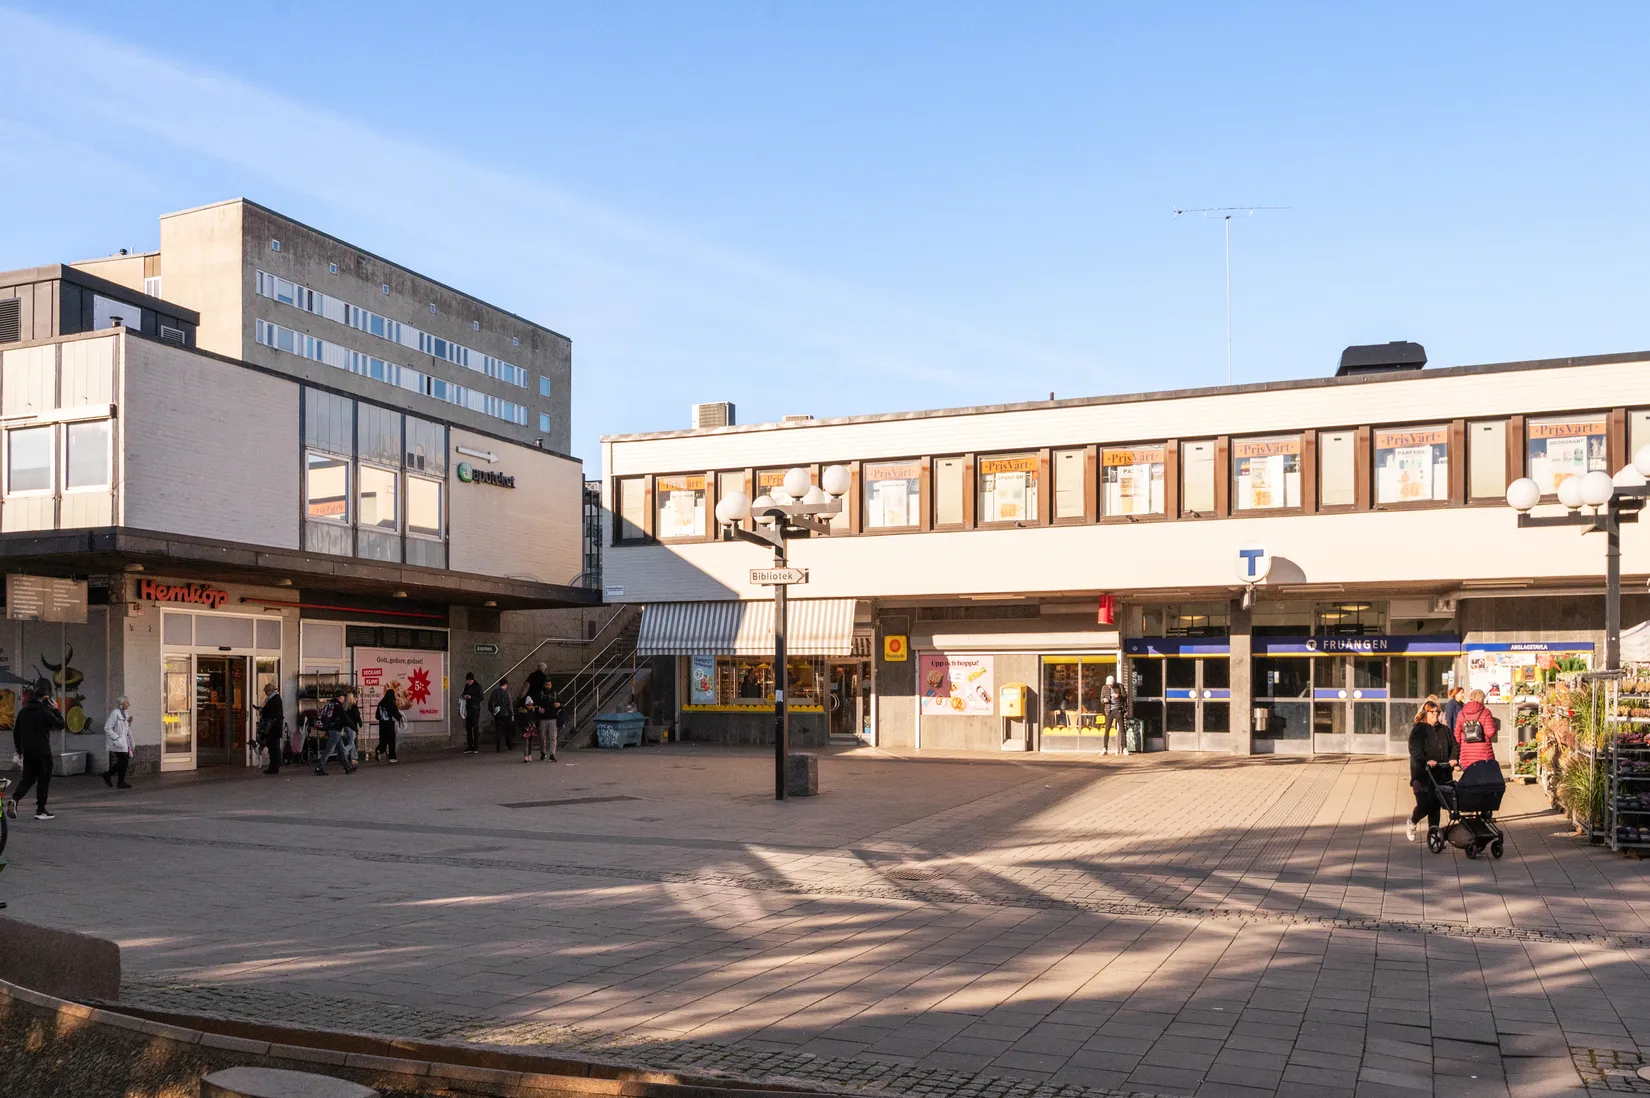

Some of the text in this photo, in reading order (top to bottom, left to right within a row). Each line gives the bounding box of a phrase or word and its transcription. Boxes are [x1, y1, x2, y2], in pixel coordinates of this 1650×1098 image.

[1540, 424, 1592, 435] PrisVärt
[1386, 432, 1434, 445] PrisVärt
[1244, 442, 1288, 454] PrisVärt
[1112, 452, 1153, 463] PrisVärt
[990, 460, 1028, 471] PrisVärt
[472, 469, 516, 488] apoteket
[874, 468, 912, 478] PrisVärt
[768, 474, 784, 484] Pris
[1240, 549, 1263, 576] T
[752, 572, 792, 580] Bibliotek
[142, 577, 228, 608] Hemköp
[1324, 638, 1387, 650] FRUÄNGEN
